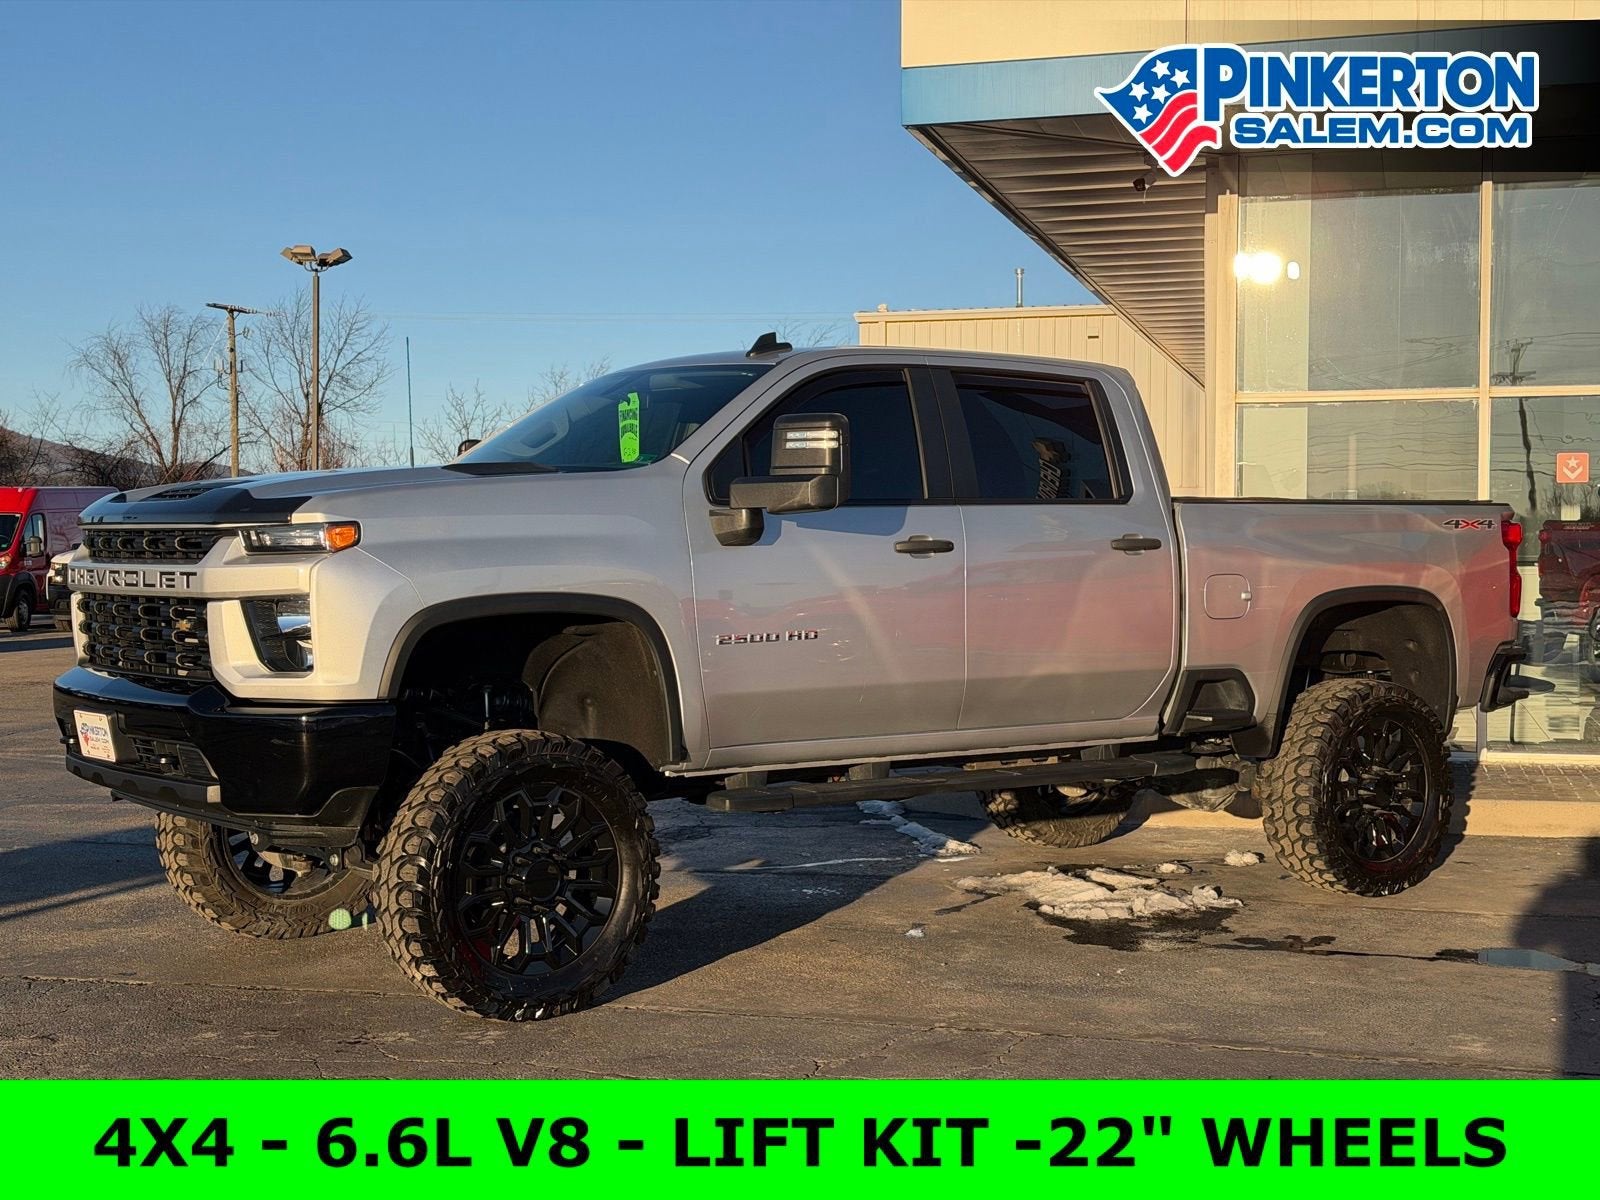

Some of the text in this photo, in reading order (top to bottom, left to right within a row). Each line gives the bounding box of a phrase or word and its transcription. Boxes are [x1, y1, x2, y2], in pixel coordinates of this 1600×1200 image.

[69, 567, 198, 589] CHEVROLET
[716, 630, 818, 645] 2500 HD
